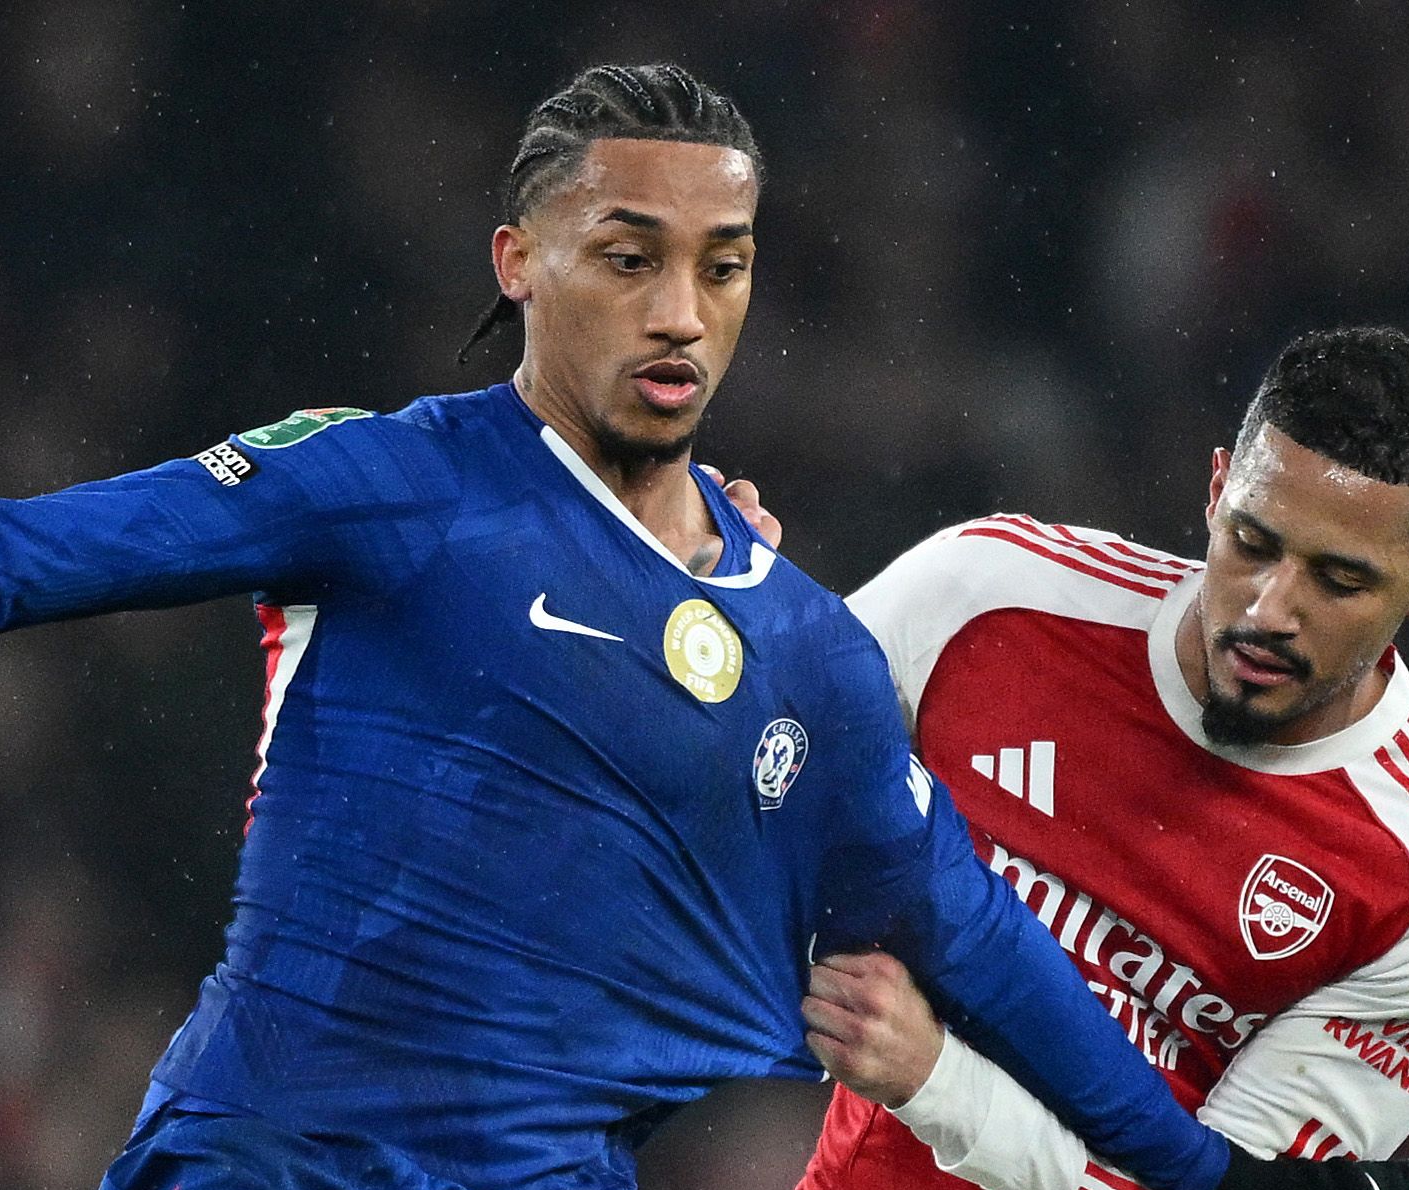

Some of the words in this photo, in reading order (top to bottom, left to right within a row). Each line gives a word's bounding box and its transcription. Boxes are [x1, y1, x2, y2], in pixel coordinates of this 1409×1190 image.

[671, 608, 694, 650] WORLD
[685, 672, 716, 696] FIFA
[772, 722, 804, 753] CHELSEA
[1261, 869, 1322, 912] Arsenal
[985, 833, 1268, 1049] mirates
